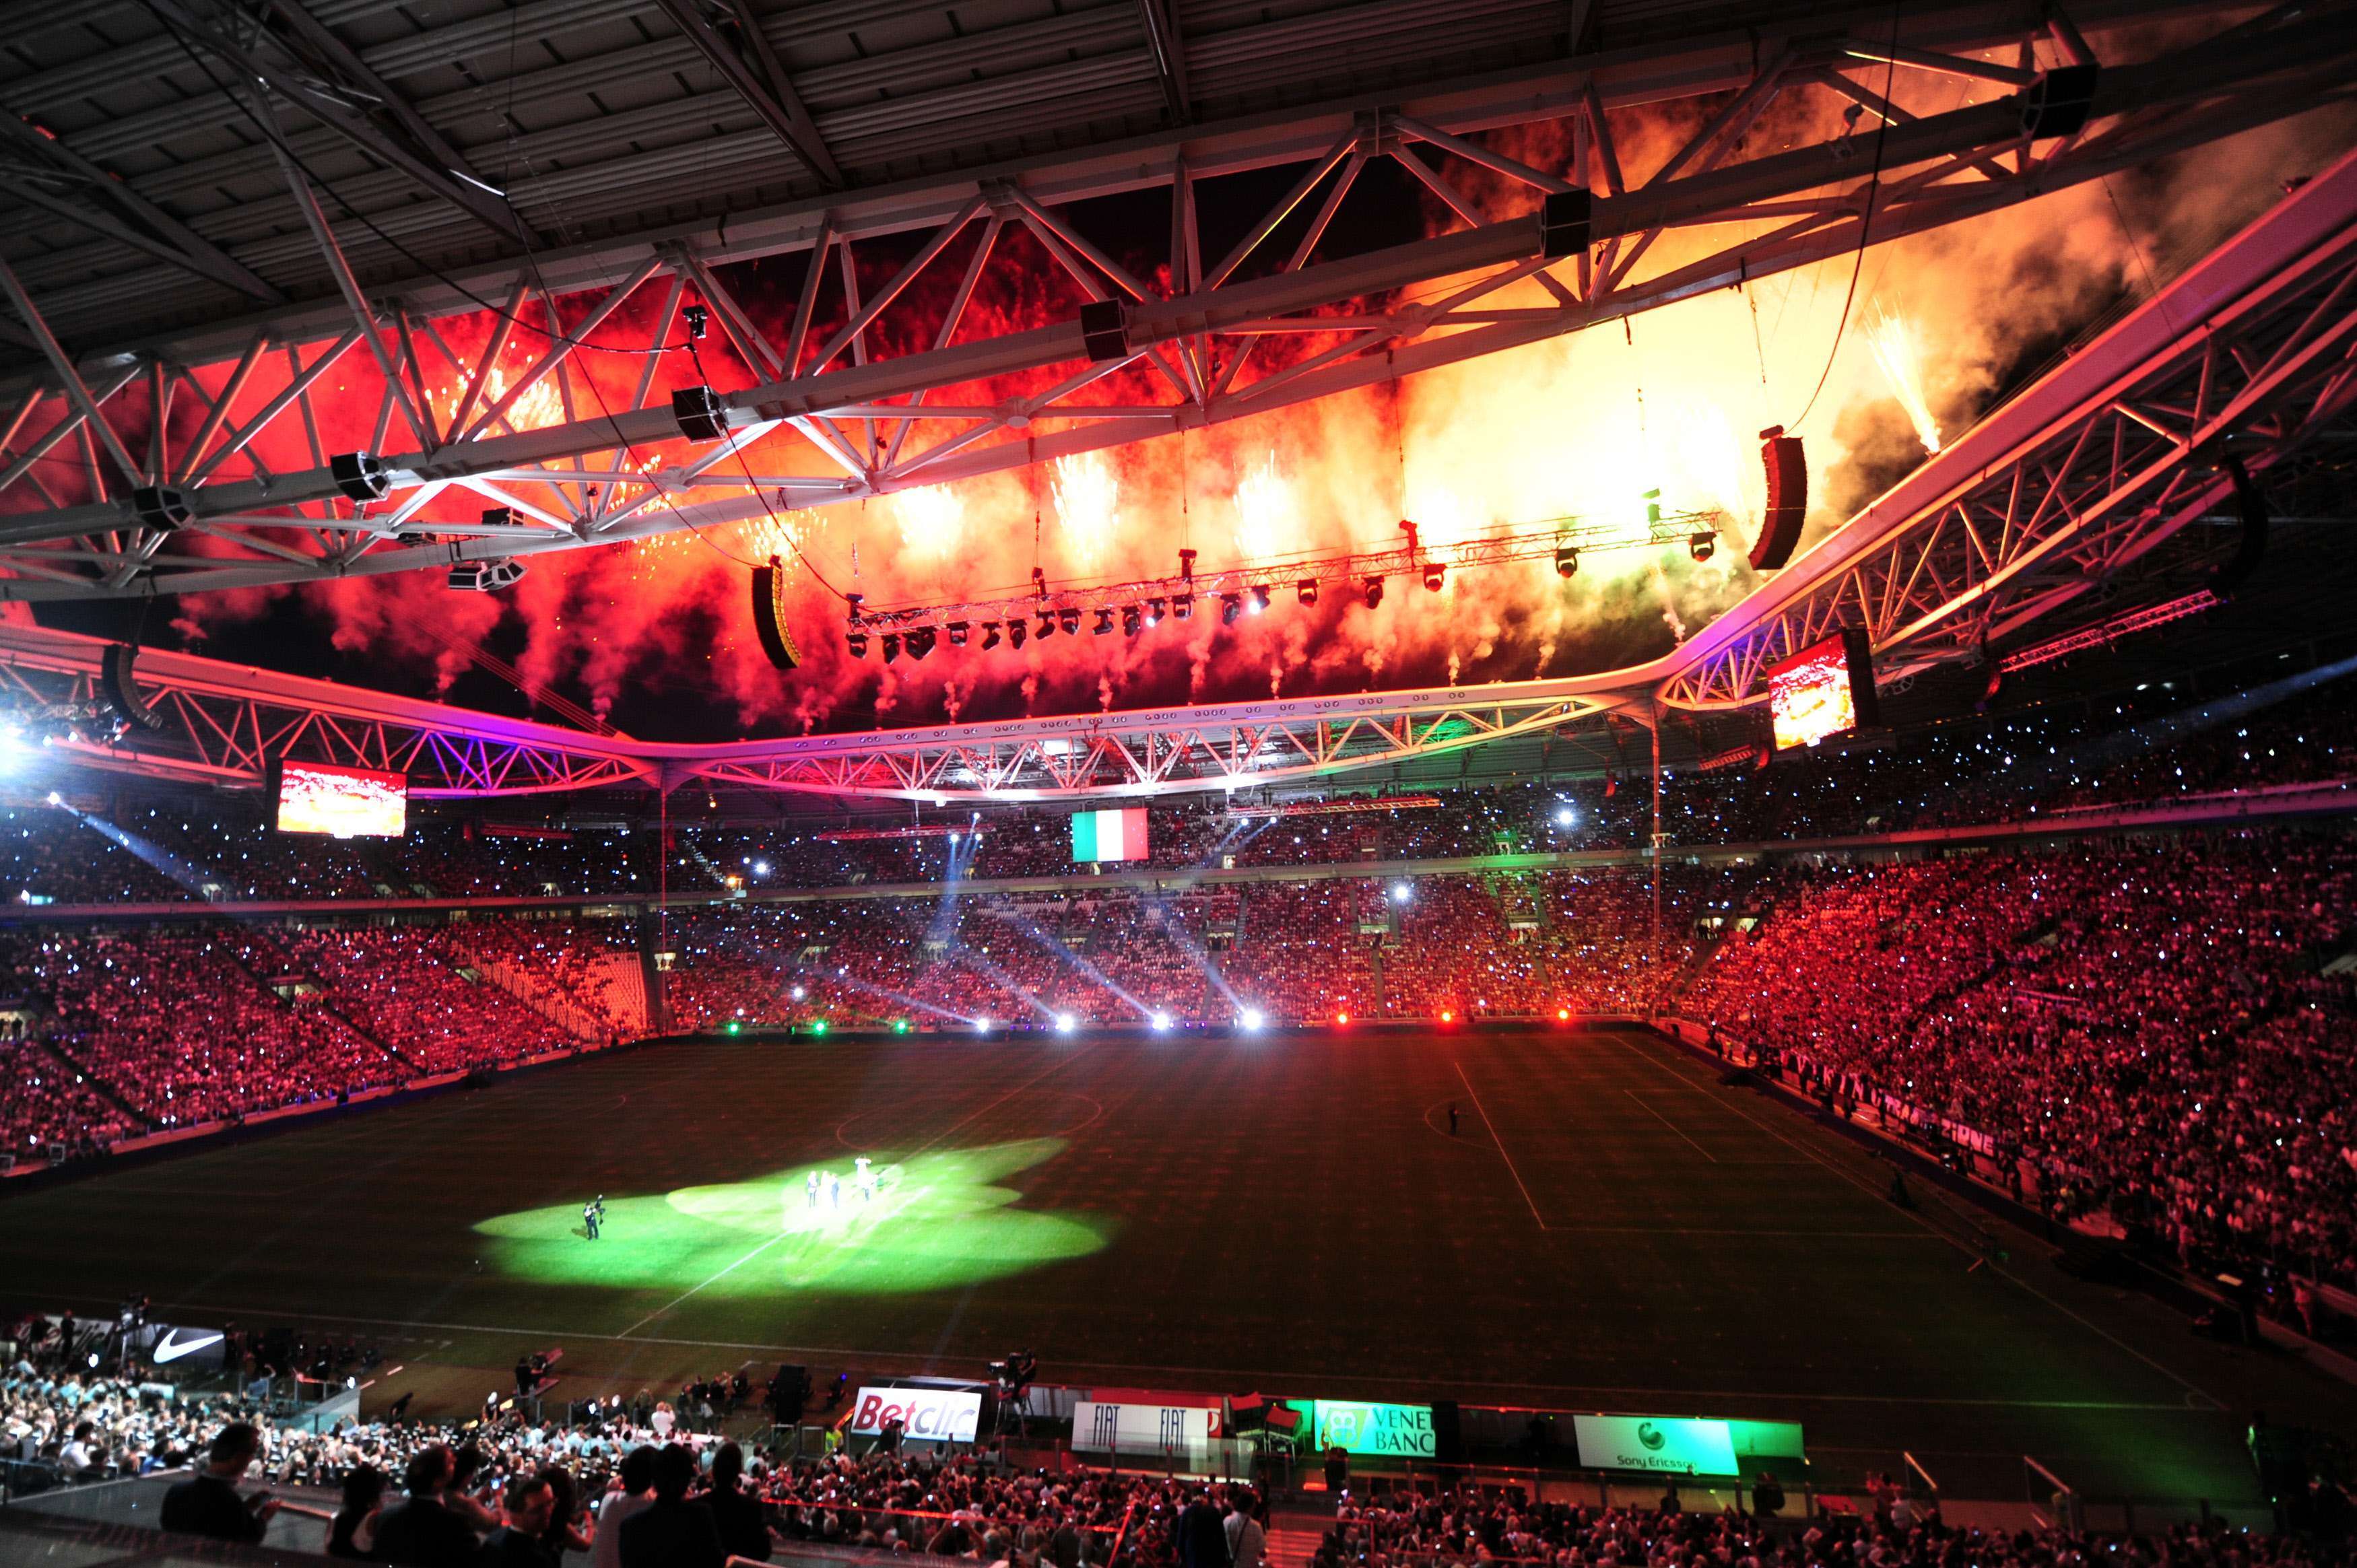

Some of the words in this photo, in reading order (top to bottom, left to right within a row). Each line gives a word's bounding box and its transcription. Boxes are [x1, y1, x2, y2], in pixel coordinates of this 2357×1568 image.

[854, 1395, 976, 1435] Betclic
[1092, 1404, 1121, 1446] FIAT
[1159, 1408, 1187, 1451] FIAT
[1372, 1406, 1434, 1431] VENET
[1375, 1431, 1434, 1454] BANC
[1617, 1454, 1647, 1468] Sony
